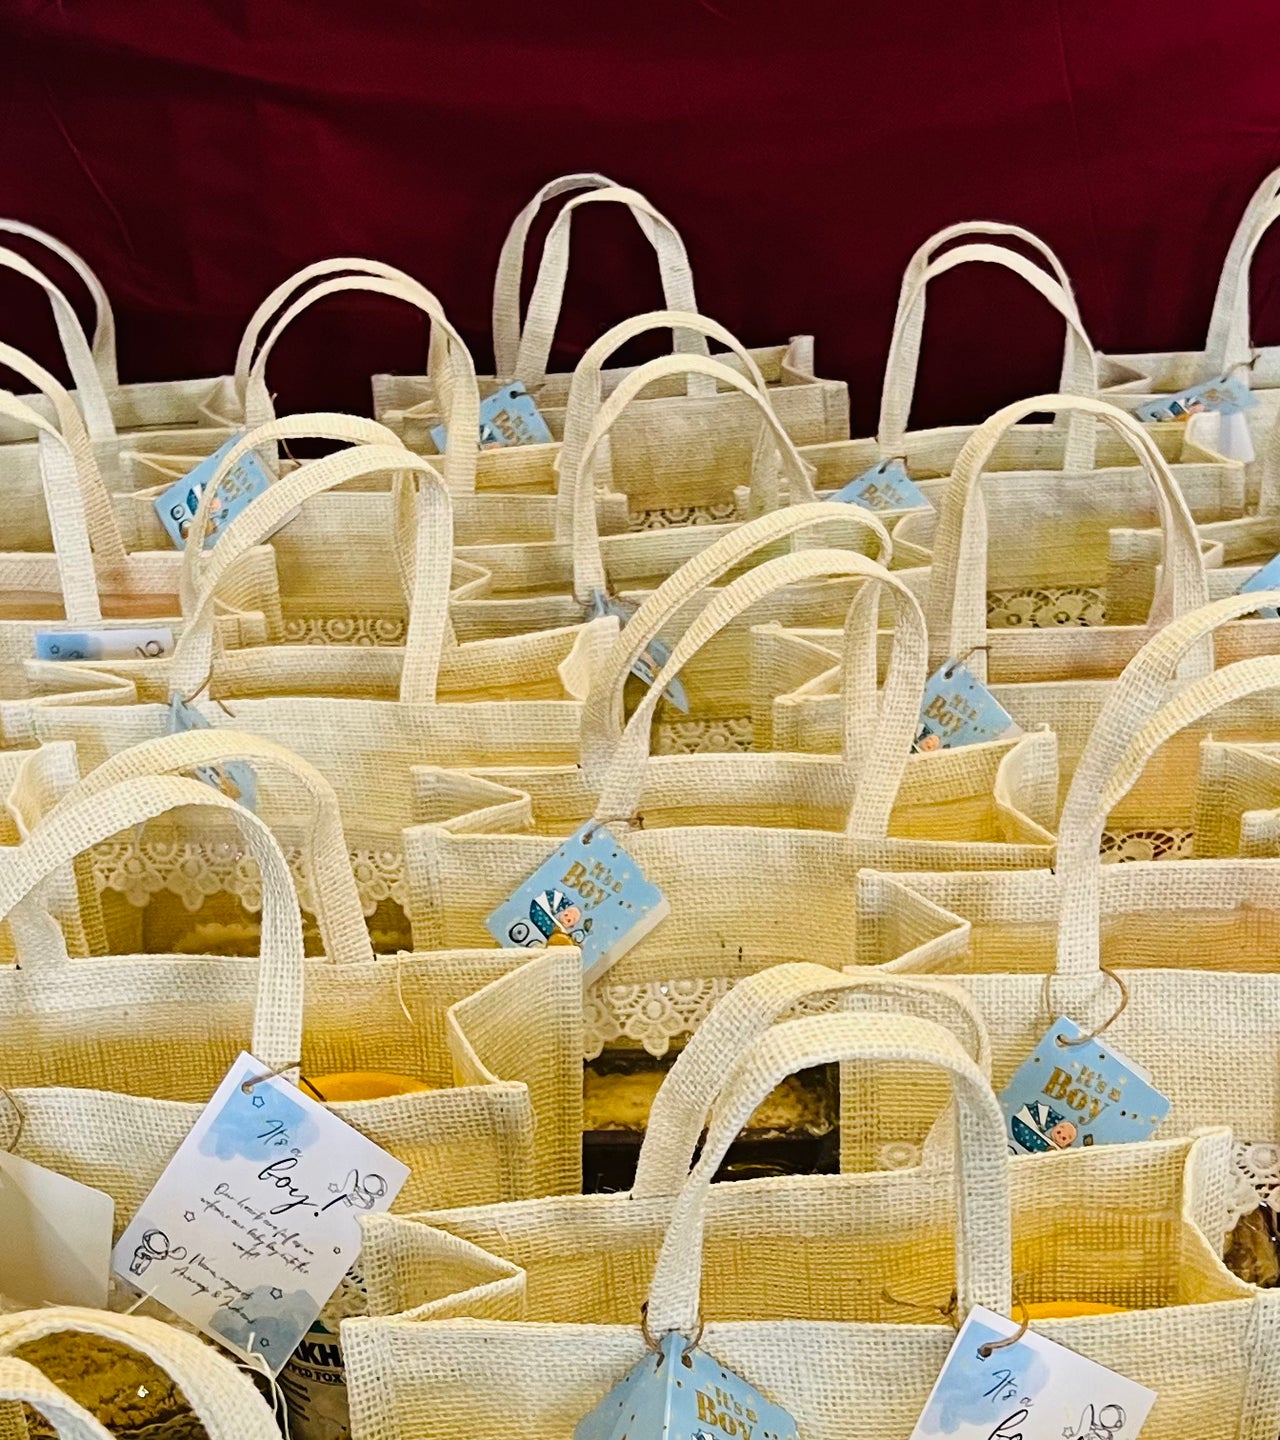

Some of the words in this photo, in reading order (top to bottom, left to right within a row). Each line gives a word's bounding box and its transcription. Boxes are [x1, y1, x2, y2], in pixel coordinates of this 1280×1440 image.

[560, 861, 611, 910] Boy
[1041, 1066, 1109, 1125] Boy
[259, 1158, 346, 1217] boy!
